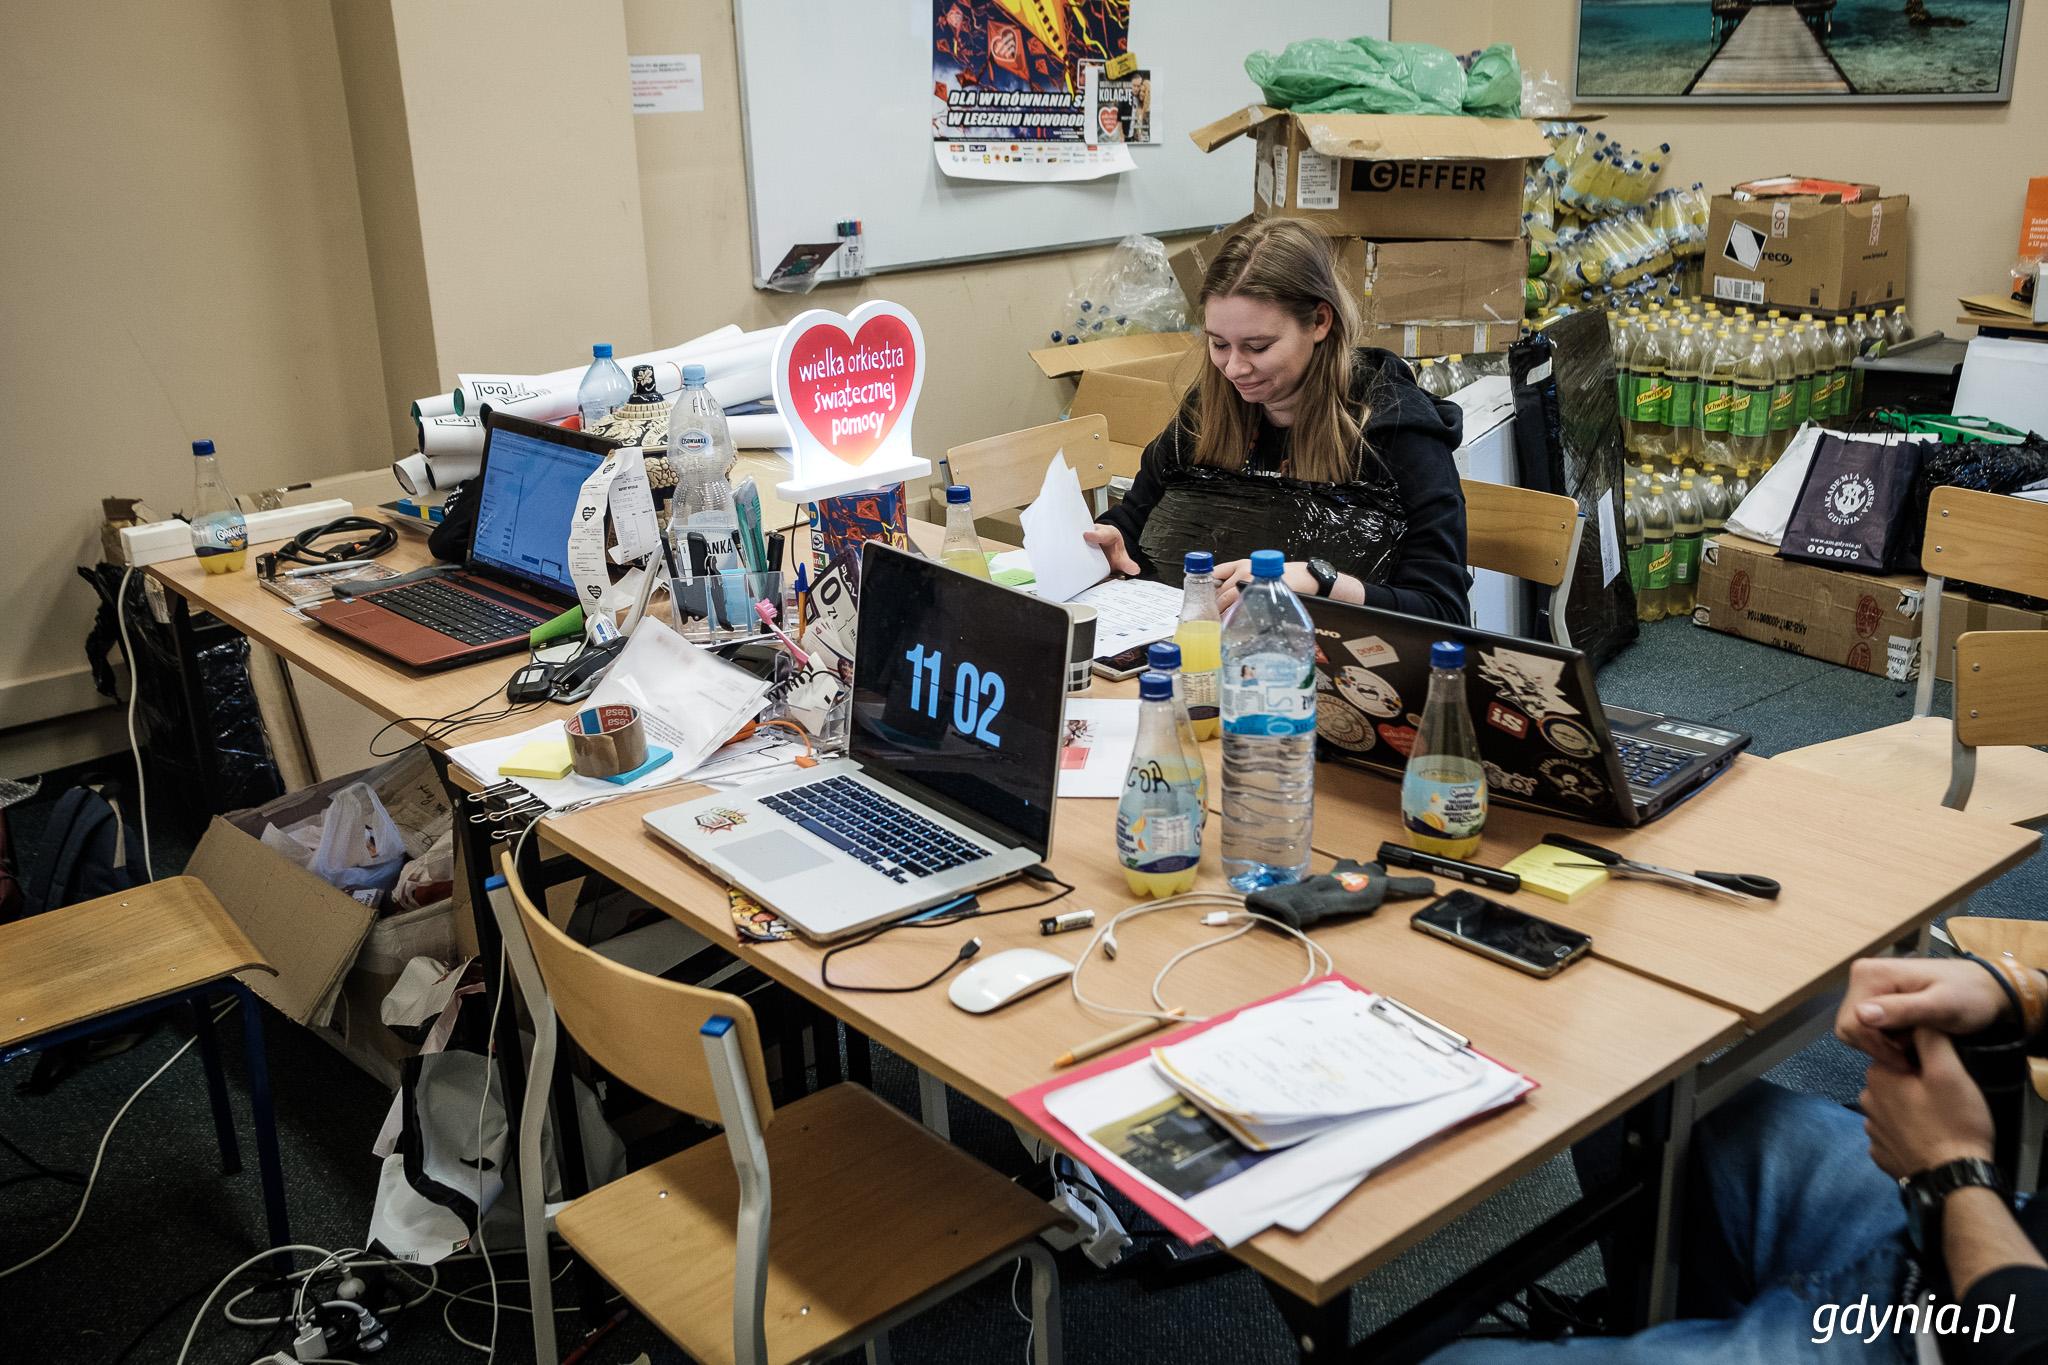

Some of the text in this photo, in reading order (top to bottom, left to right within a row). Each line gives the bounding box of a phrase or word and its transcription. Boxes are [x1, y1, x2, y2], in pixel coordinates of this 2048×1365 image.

[948, 91, 977, 105] DLA
[979, 90, 1072, 107] WYRÓWNANIA
[947, 111, 1085, 128] W LECZENIU NOWOROD
[1369, 161, 1486, 191] GEFFER
[799, 341, 904, 383] wielka orkiestra
[814, 374, 896, 414] świątecznej
[832, 411, 885, 445] pomocy
[1824, 472, 1875, 513] AKADEMIA MORSKA
[1828, 512, 1860, 526] GDYNIA
[905, 643, 1005, 748] 11 02
